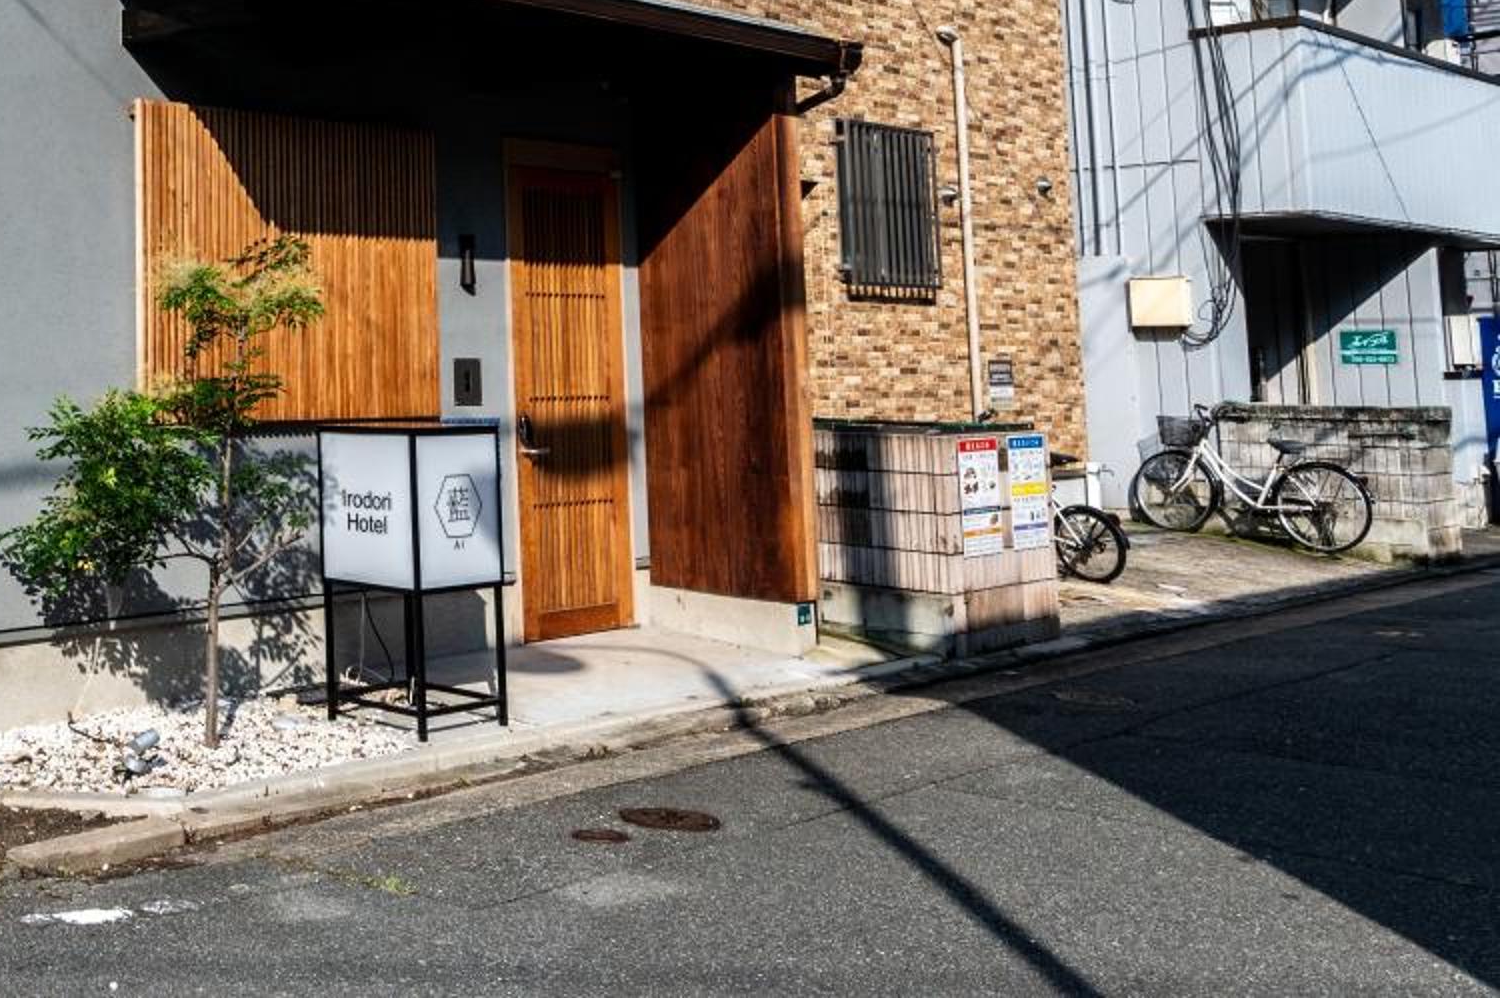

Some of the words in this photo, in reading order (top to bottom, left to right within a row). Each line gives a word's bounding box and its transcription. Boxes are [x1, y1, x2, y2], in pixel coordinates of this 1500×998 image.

[341, 489, 391, 511] Irodori
[448, 487, 470, 522] 藍
[347, 513, 388, 534] Hotel
